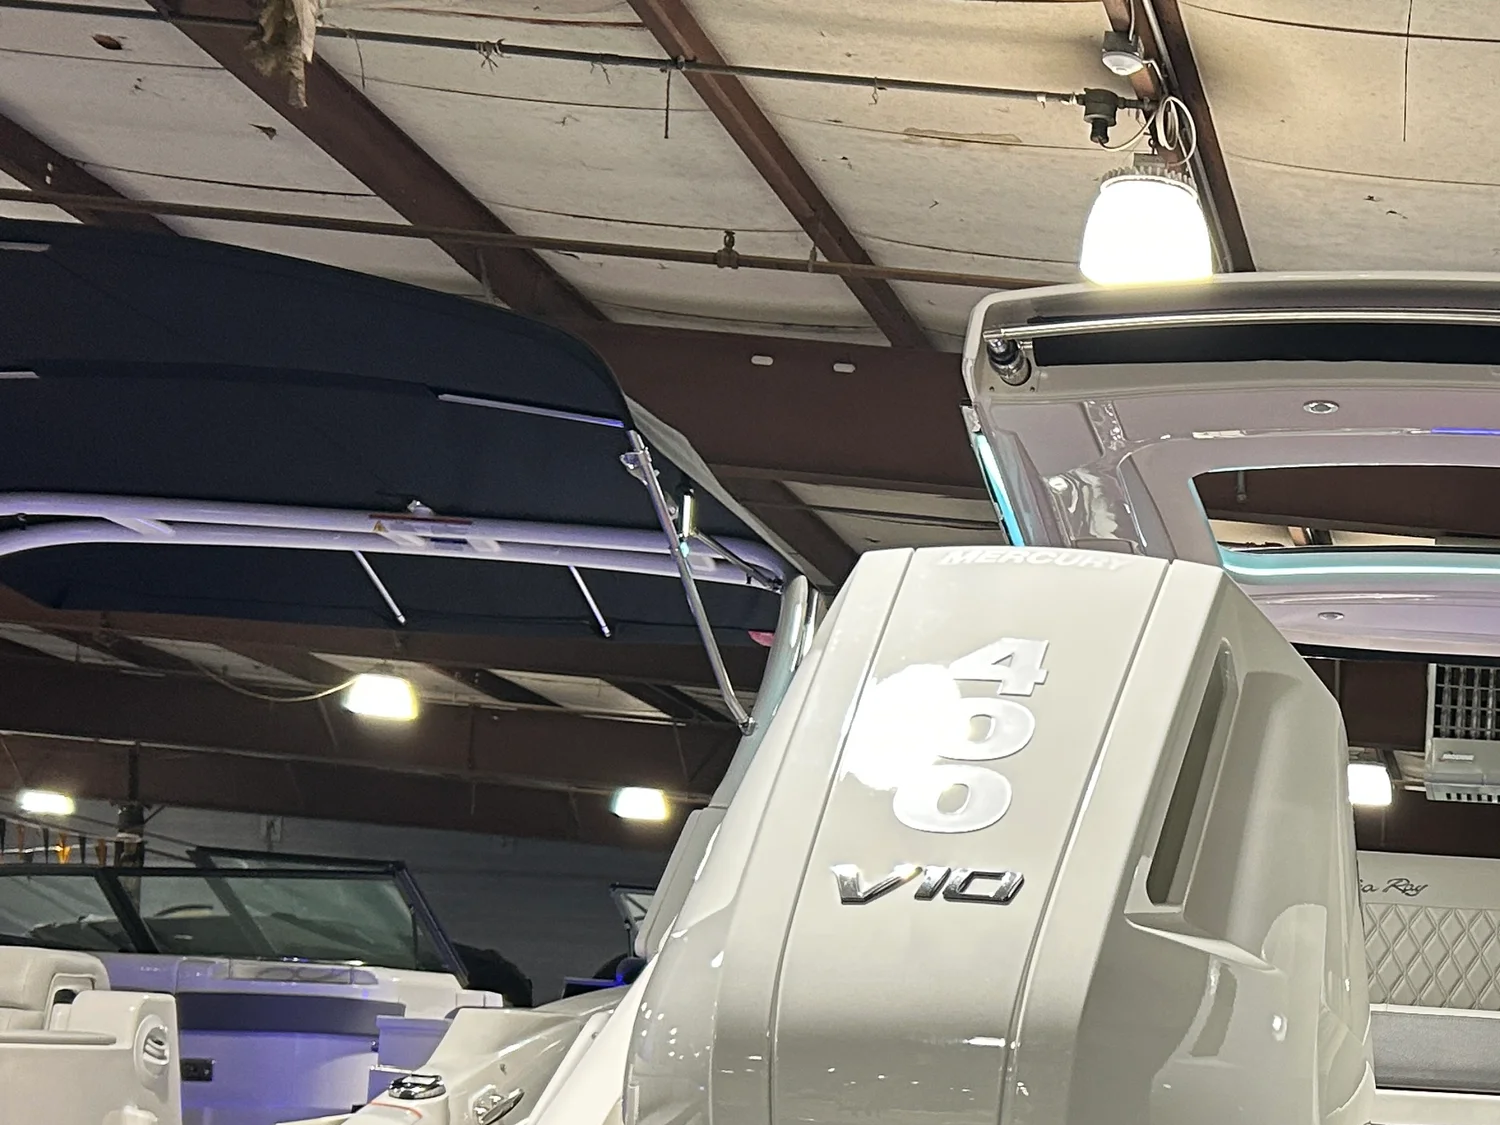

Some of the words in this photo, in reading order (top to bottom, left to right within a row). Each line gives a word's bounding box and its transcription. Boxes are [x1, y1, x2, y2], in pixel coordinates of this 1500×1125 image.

[936, 549, 1135, 571] MERCURY
[891, 637, 1050, 835] 400
[830, 863, 1025, 906] V10
[1382, 878, 1429, 897] Ray
